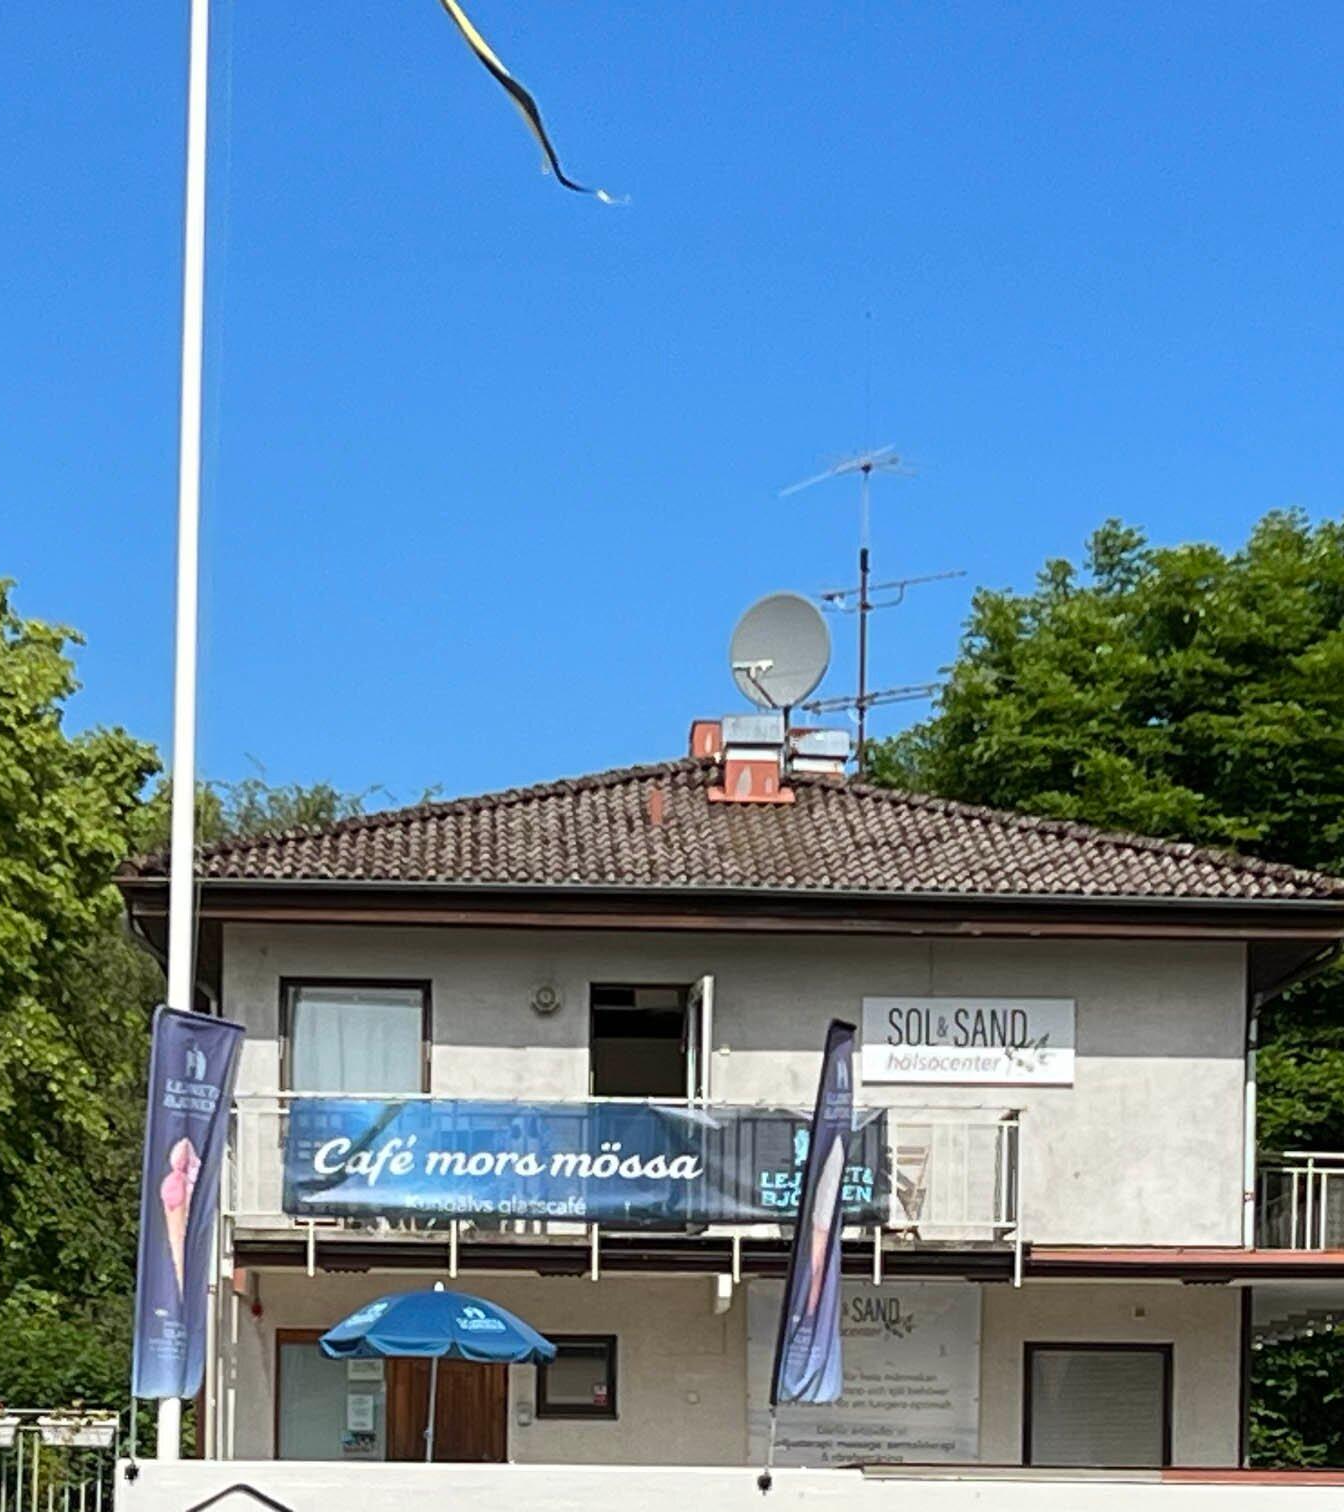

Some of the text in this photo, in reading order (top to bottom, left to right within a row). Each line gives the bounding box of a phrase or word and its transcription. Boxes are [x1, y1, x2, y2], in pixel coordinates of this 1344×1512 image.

[312, 1135, 705, 1188] Café mors mössa
